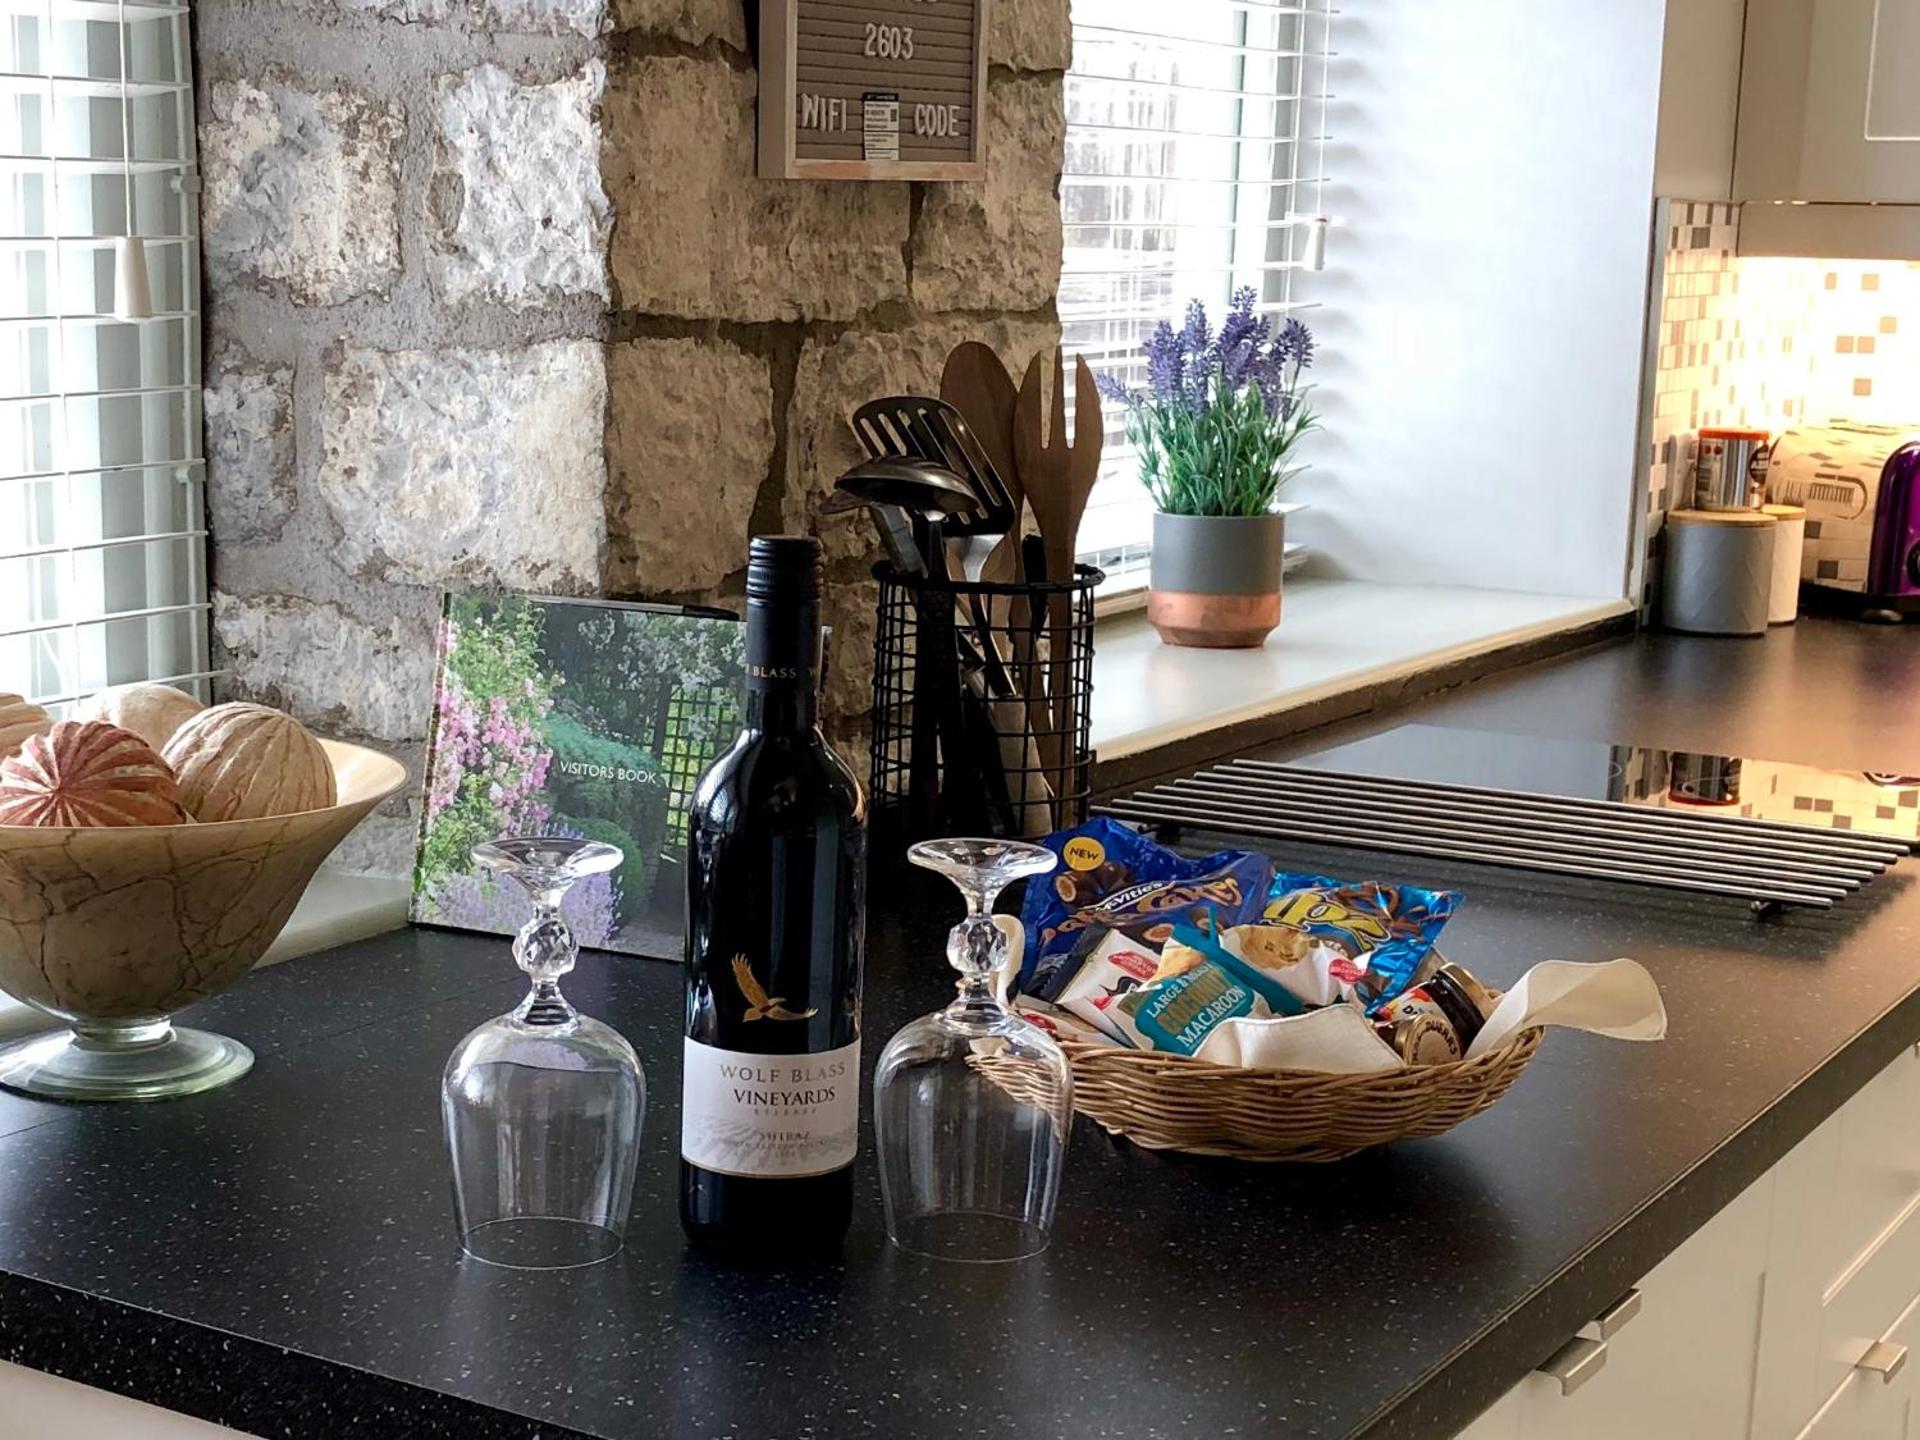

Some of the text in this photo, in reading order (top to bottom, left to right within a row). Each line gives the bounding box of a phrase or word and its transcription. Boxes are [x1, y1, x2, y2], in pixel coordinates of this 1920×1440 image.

[864, 22, 914, 60] 2603
[800, 93, 847, 134] WIFI
[914, 103, 961, 138] CODE
[752, 665, 797, 679] BLASS
[560, 760, 656, 784] VISITORS BOOK
[1069, 847, 1099, 861] NEW
[1146, 982, 1182, 1018] LARGE
[1176, 984, 1247, 1047] MACAROON
[720, 1061, 846, 1084] WOLF BLASS
[734, 1086, 836, 1107] VINEYARDS
